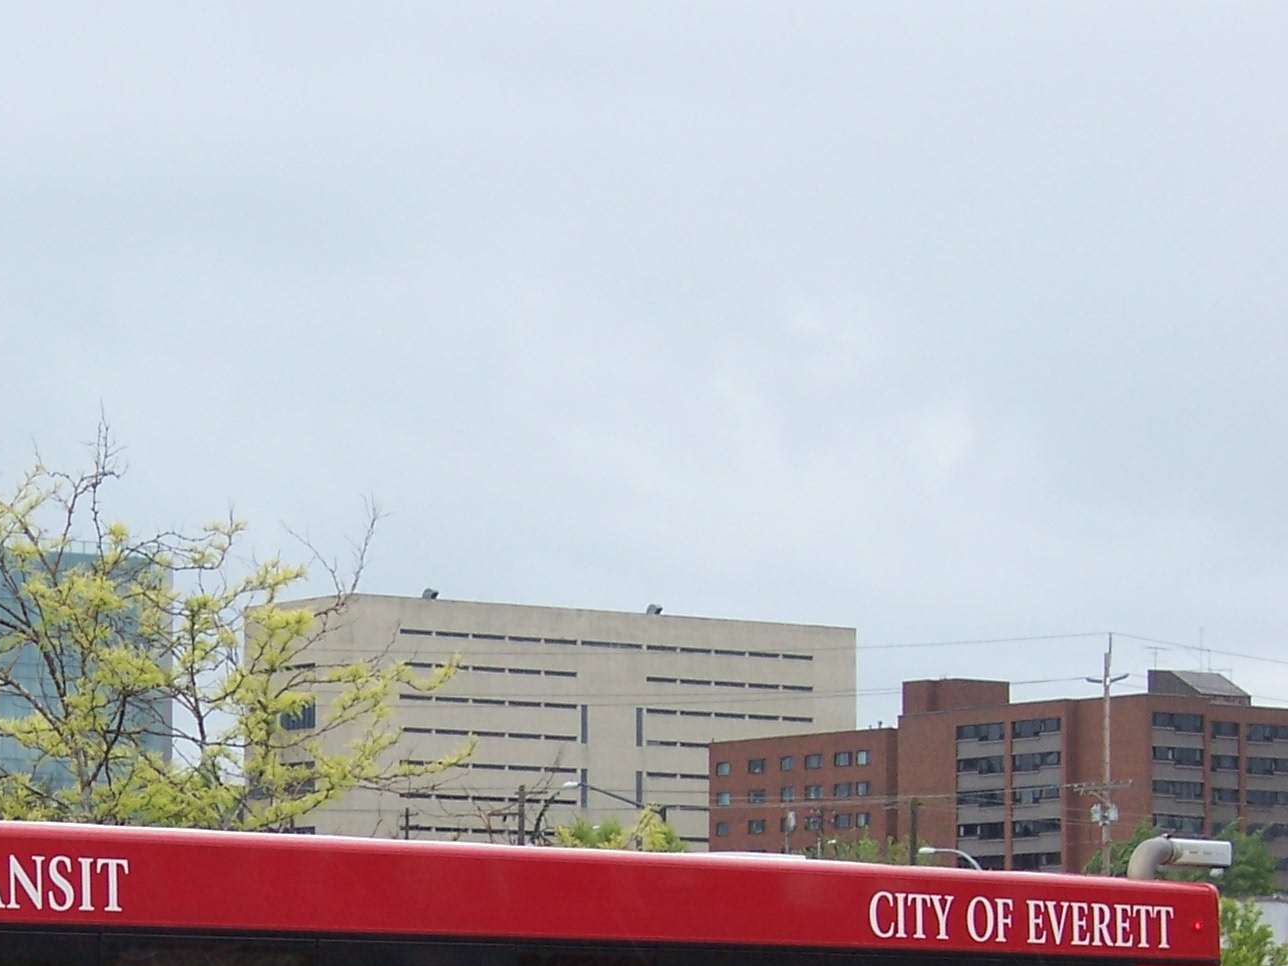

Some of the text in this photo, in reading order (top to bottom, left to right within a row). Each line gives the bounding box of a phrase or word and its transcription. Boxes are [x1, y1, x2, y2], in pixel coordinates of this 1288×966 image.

[869, 891, 1174, 949] CITY OF EVERETT
